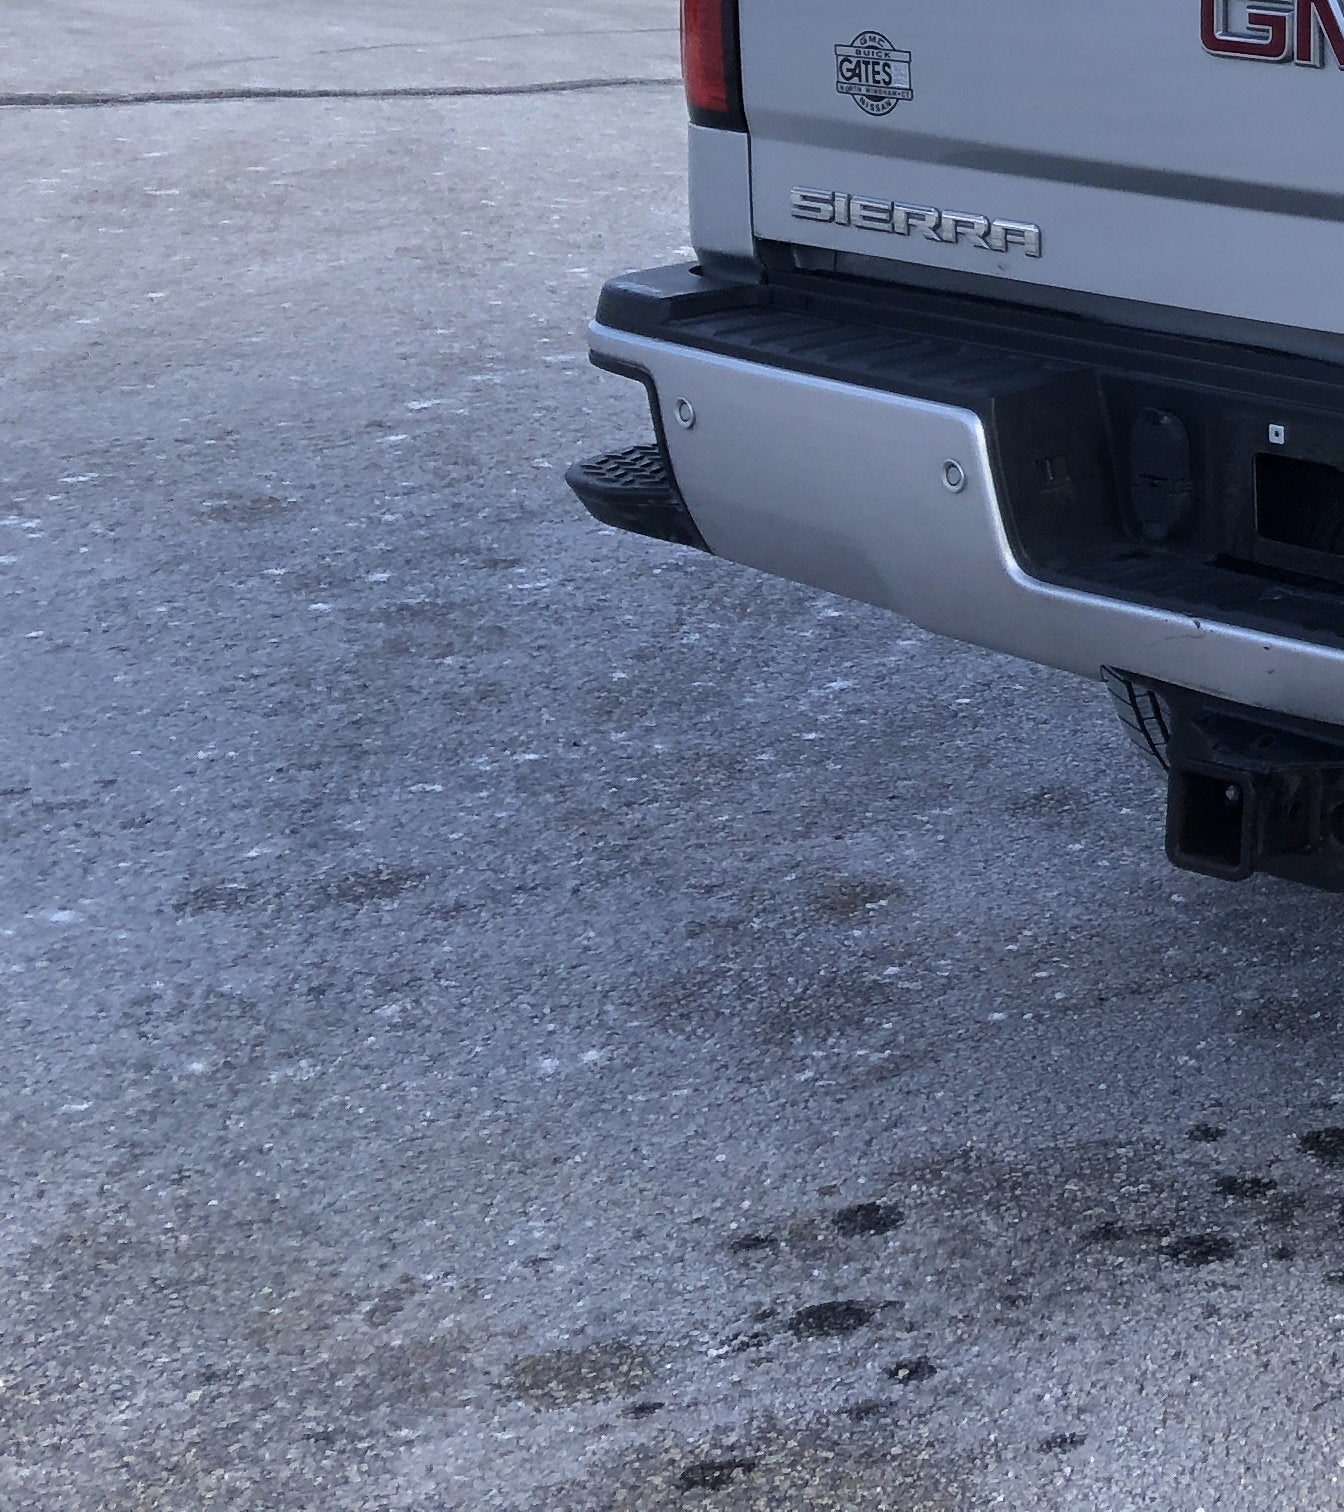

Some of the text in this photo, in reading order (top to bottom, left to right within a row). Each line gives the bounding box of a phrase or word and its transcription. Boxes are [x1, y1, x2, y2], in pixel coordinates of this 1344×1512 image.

[860, 35, 886, 48] GMC
[855, 48, 891, 59] BUICK
[839, 56, 893, 87] GATES
[859, 96, 892, 112] NISSAN
[790, 185, 1042, 258] SIERRA
